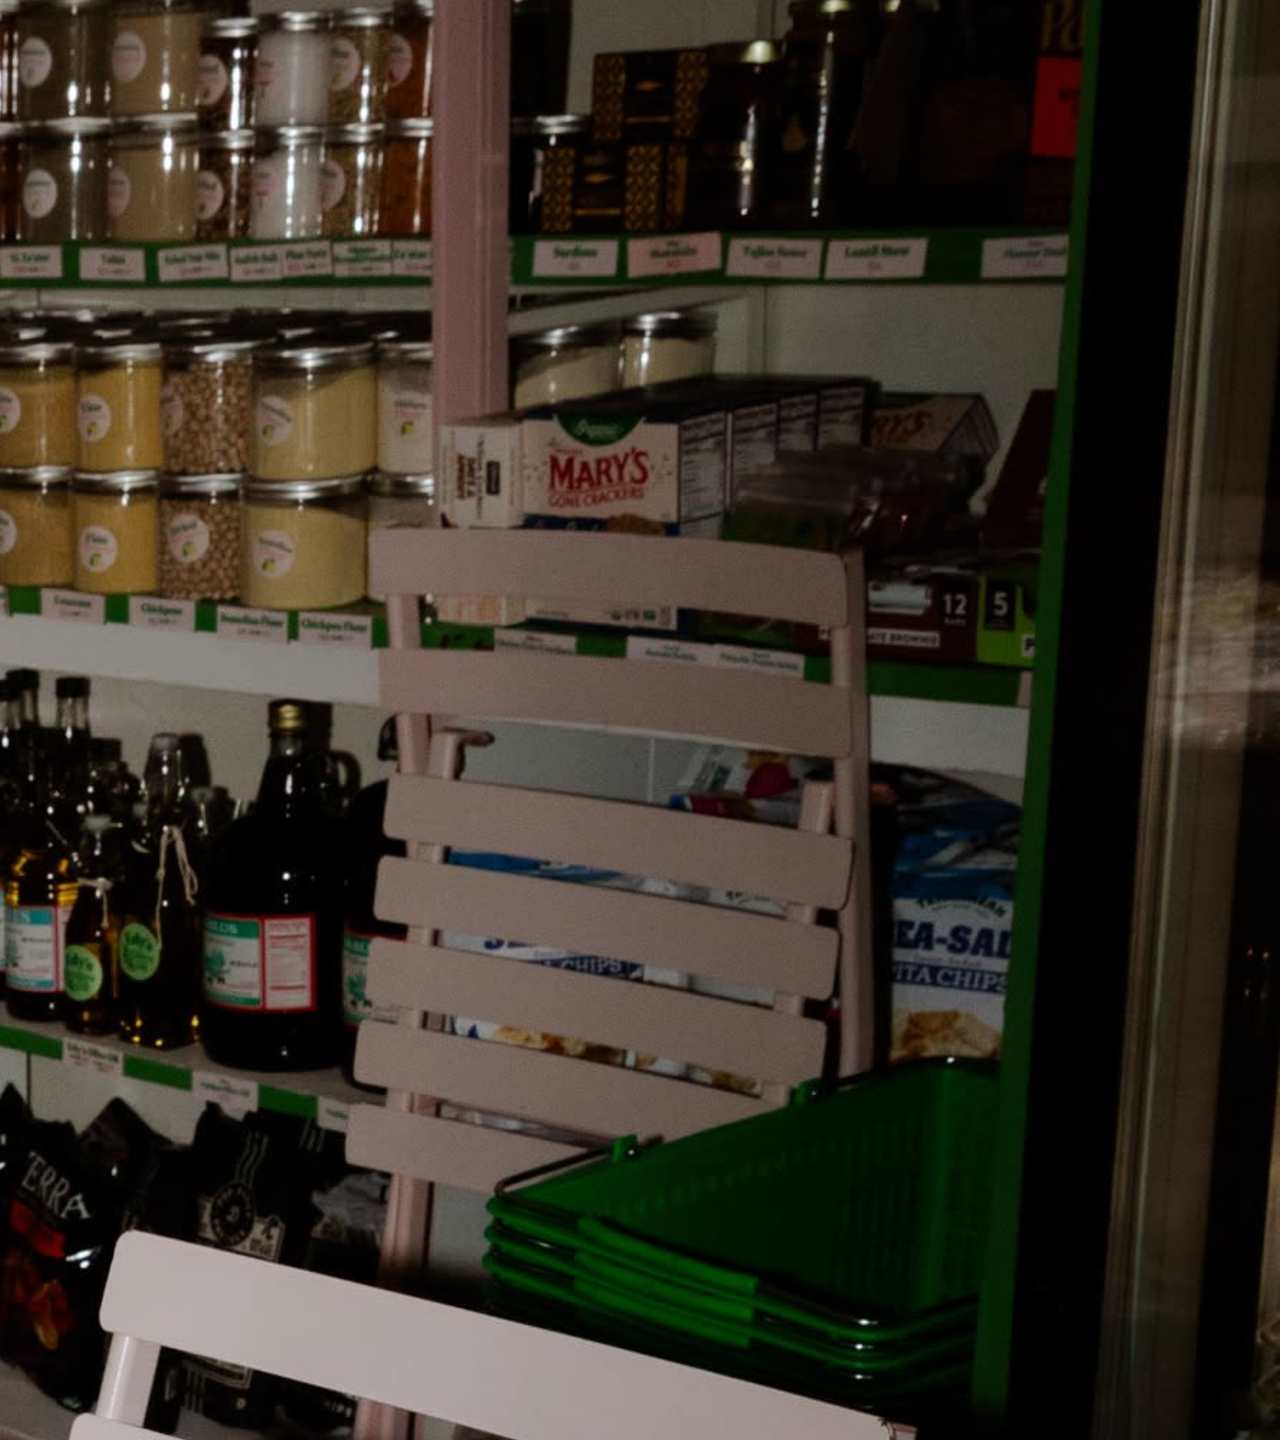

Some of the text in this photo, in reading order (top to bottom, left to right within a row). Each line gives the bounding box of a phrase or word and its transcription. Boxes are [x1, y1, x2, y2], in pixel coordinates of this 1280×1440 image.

[548, 448, 649, 494] MARY'S
[944, 593, 968, 616] 12
[993, 593, 1009, 616] 5
[894, 920, 1012, 959] EA-SAL
